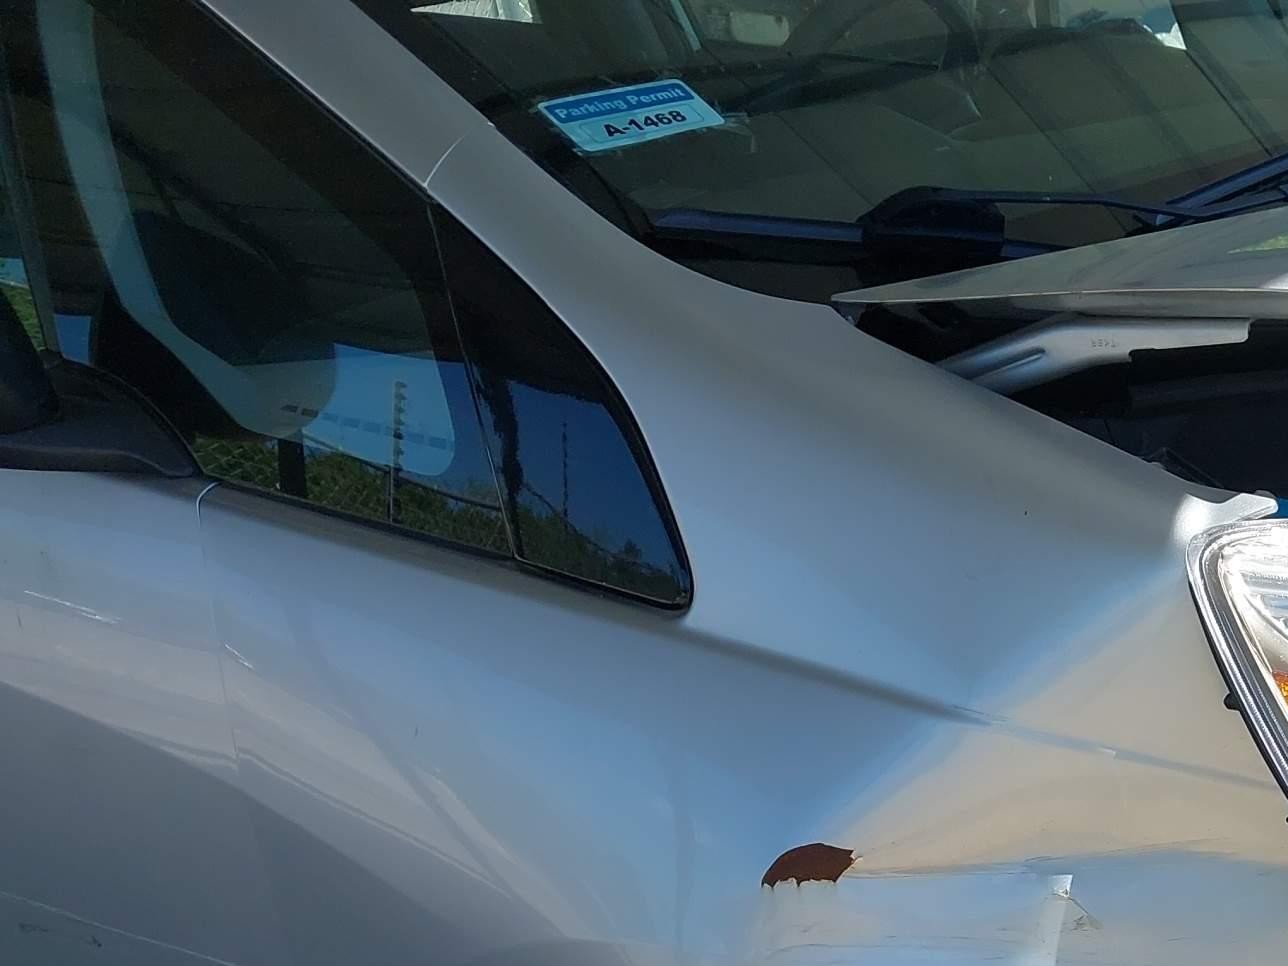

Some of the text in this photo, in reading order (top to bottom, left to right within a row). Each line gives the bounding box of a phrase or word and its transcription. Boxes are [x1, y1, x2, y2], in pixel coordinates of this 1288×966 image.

[554, 87, 686, 119] Parking Permit
[603, 110, 687, 137] A-1468
